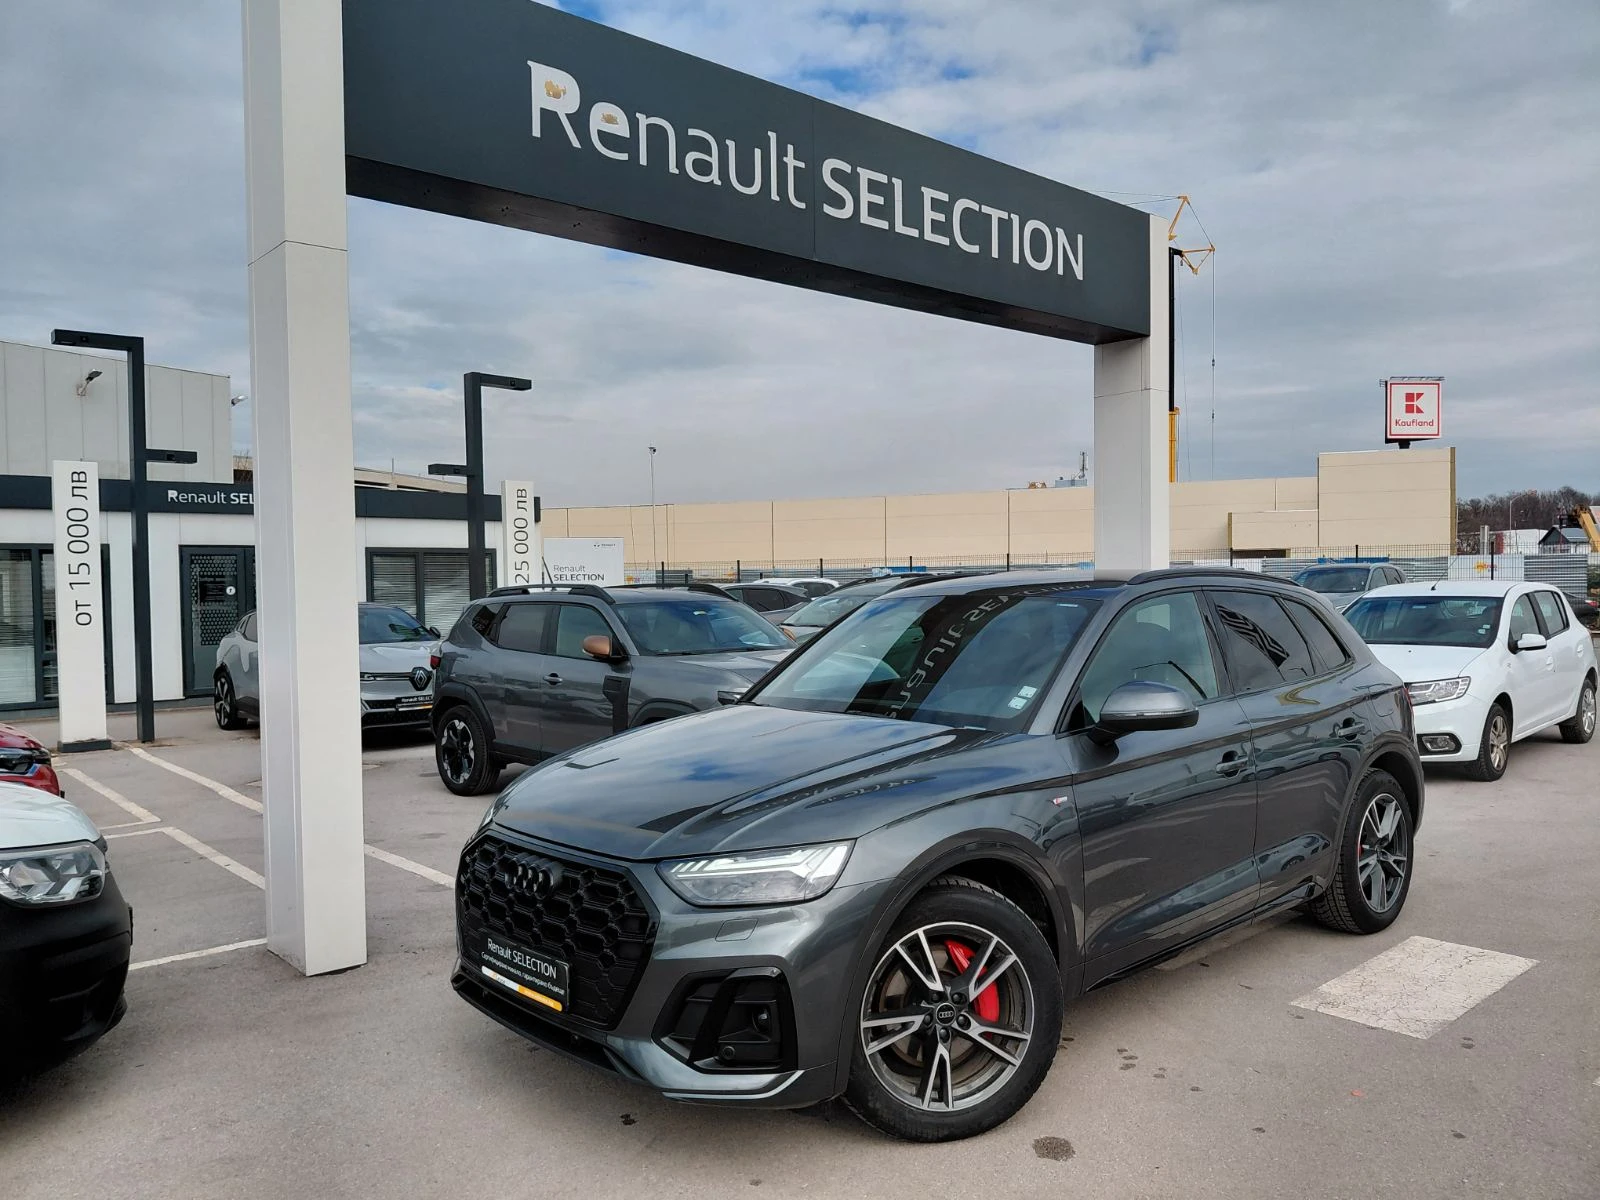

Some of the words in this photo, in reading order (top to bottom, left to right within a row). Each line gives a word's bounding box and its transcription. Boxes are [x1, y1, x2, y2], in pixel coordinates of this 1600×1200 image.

[527, 60, 806, 209] Renault
[821, 158, 1084, 281] SELECTION
[1395, 418, 1434, 427] Kaufland
[167, 489, 227, 504] Renault
[230, 492, 254, 504] SEL
[66, 507, 90, 554] 000
[513, 517, 529, 555] 000
[68, 562, 91, 590] 15
[514, 560, 530, 584] 25
[553, 564, 586, 572] Renault
[553, 573, 605, 582] SELECTION
[487, 937, 511, 960] Renault
[512, 950, 557, 979] SELECTION
